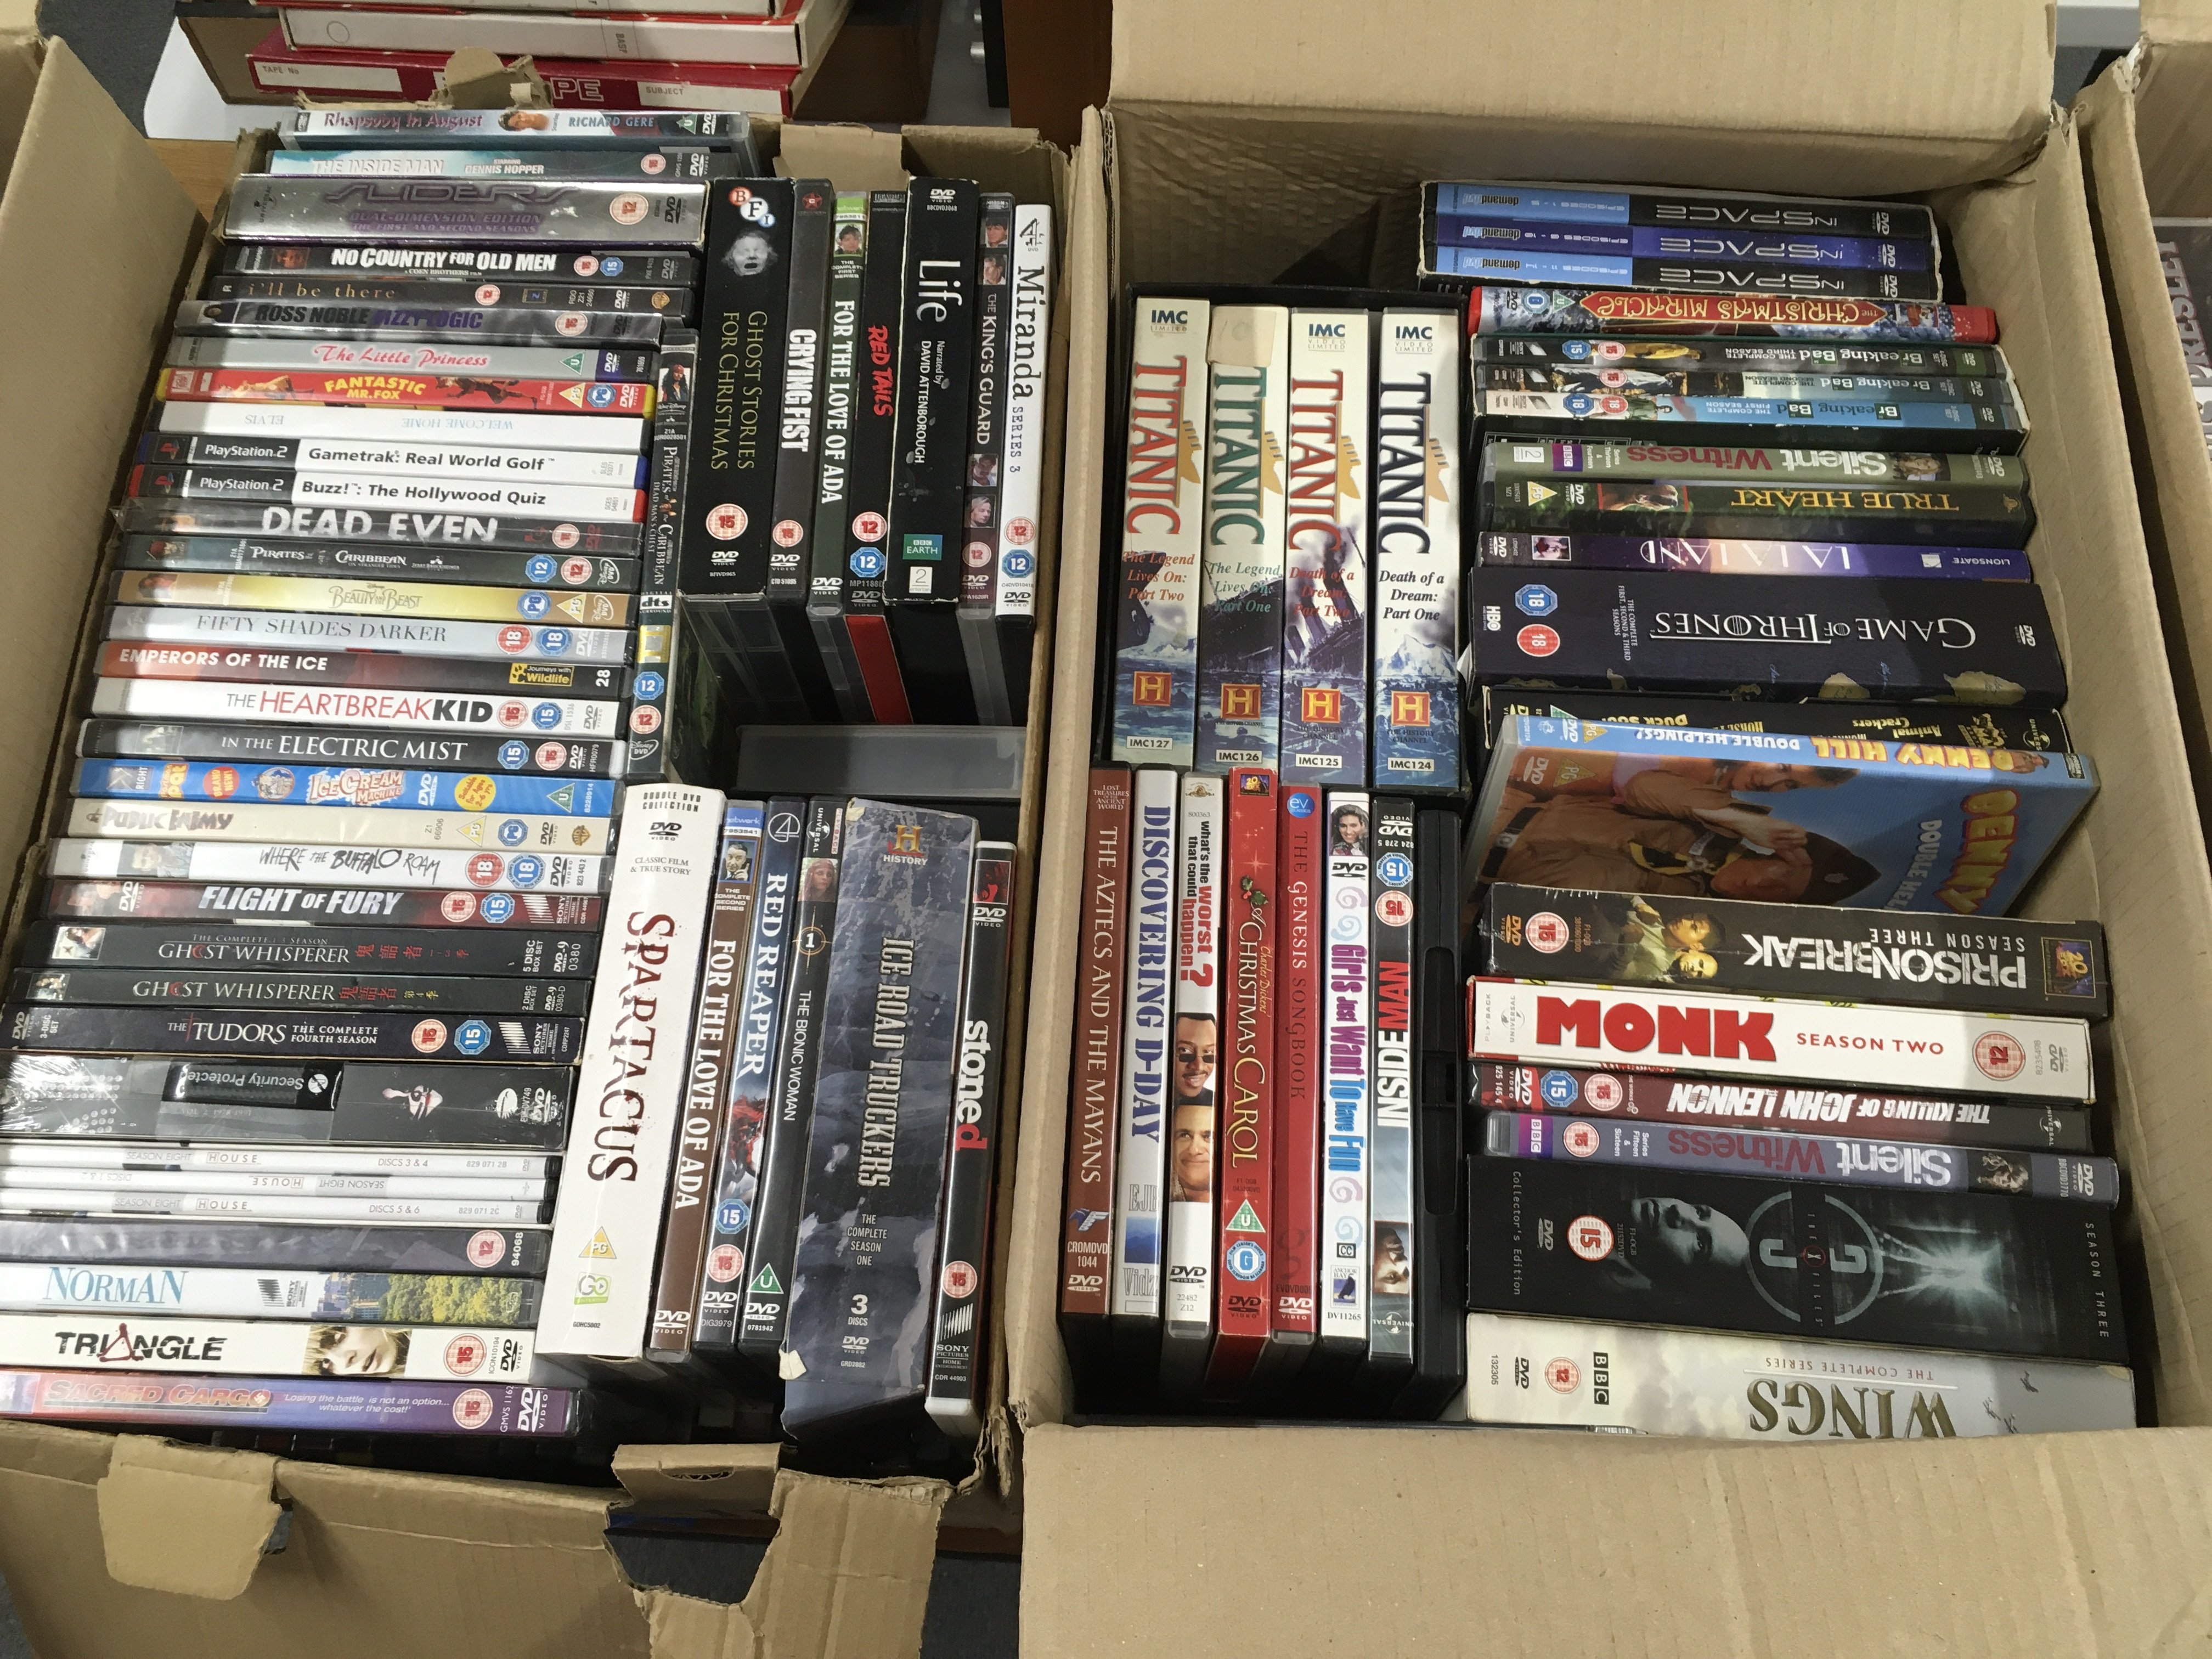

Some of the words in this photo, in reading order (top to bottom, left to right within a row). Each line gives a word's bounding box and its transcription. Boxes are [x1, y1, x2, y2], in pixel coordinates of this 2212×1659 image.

[263, 66, 284, 75] TAPE
[646, 87, 684, 96] SUBJECT
[568, 116, 620, 127] RICHARD
[626, 117, 654, 128] GERE
[465, 165, 501, 174] DENNIS
[504, 165, 544, 174] HOPPER
[331, 249, 358, 267] NO
[360, 249, 447, 268] COUNTRY
[449, 253, 474, 266] FOR
[477, 252, 512, 270] OLD
[515, 253, 557, 272] MEN
[915, 259, 962, 323] Life
[255, 306, 306, 323] ROSS
[309, 307, 368, 324] NOBLE
[1150, 309, 1188, 325] IMC
[1599, 295, 1708, 319] MIRACLE
[1717, 300, 1860, 323] CHRISTMAS
[720, 312, 741, 349] FOR
[867, 324, 889, 365] RED
[979, 314, 998, 376] KING'S
[1308, 323, 1346, 338] IMC
[744, 310, 768, 382] GHOST
[918, 340, 933, 375] DAVID
[783, 329, 818, 402] CRYING
[324, 376, 426, 396] FANTASTIC
[346, 389, 373, 399] MR.
[373, 390, 400, 400] FOX
[871, 366, 894, 418] TAILS
[711, 351, 739, 470] CHRISTMAS
[912, 377, 929, 465] ATTENBOROUGH
[977, 380, 995, 445] GUARD
[737, 385, 759, 469] STORIES
[781, 405, 814, 453] FIST
[1126, 355, 1188, 535] TITANIC
[1627, 447, 1773, 471] Witness
[405, 453, 443, 466] Real
[449, 455, 501, 468] World
[507, 456, 545, 472] Golf
[1288, 369, 1344, 551] TITANIC
[1376, 371, 1432, 555] TITANIC
[1782, 449, 1887, 476] Silent
[369, 485, 399, 498] The
[405, 486, 501, 504] Hollywood
[507, 490, 546, 506] Quiz
[1731, 488, 1855, 508] HEART
[1864, 493, 1960, 511] TRUE
[262, 506, 373, 539] DEAD
[387, 513, 498, 542] EVEN
[906, 544, 939, 556] EARTH
[1953, 557, 2011, 566] LIONSGATE
[1379, 570, 1418, 584] Death
[1419, 572, 1434, 586] of
[1435, 574, 1444, 585] a
[1390, 588, 1438, 602] Dream:
[197, 614, 261, 633] FIFTY
[265, 617, 352, 637] SHADES
[360, 622, 447, 642] DARKER
[1383, 607, 1412, 621] Part
[1414, 608, 1441, 622] One
[1486, 606, 1501, 631] HBO
[119, 648, 219, 666] EMPERORS
[225, 652, 252, 668] OF
[257, 654, 290, 669] THE
[295, 656, 328, 671] ICE
[527, 673, 570, 684] Wildlife
[596, 669, 611, 687] 28
[222, 737, 239, 748] IN
[244, 738, 274, 750] THE
[278, 735, 401, 759] ELECTRIC
[404, 741, 468, 760] MIST
[1129, 738, 1170, 749] IMC127
[1218, 752, 1260, 761] IMC126
[1390, 760, 1431, 771] IMC124
[1098, 826, 1118, 868] THE
[1188, 836, 1198, 861] that
[1200, 821, 1211, 861] what's
[634, 856, 666, 865] CLASSIC
[668, 858, 690, 866] FILM
[883, 854, 929, 866] HISTORY
[1199, 861, 1209, 884] the
[1187, 862, 1197, 897] could
[199, 885, 302, 912] FLIGHT
[301, 893, 325, 909] OF
[325, 891, 404, 916] FURY
[763, 872, 788, 938] RED
[1093, 873, 1116, 958] AZTECS
[1136, 805, 1171, 1028] DISCOVERING
[1197, 885, 1214, 954] worst
[1869, 927, 1934, 946] THREE
[1946, 933, 2026, 952] SEASON
[708, 939, 737, 988] FOR
[880, 936, 916, 977] ICE
[797, 990, 812, 1016] THE
[1091, 965, 1111, 1018] AND
[1378, 961, 1409, 1030] MAN
[697, 993, 730, 1042] THE
[735, 943, 781, 1079] REAPER
[872, 983, 912, 1051] ROAD
[167, 1022, 187, 1032] THE
[193, 1023, 287, 1044] TUDORS
[292, 1025, 315, 1033] THE
[319, 1025, 379, 1035] COMPLETE
[790, 1019, 809, 1064] BIONIC
[1536, 994, 1778, 1063] MONK
[1087, 1025, 1109, 1071] THE
[1796, 1032, 1884, 1051] SEASON
[1891, 1039, 1944, 1056] TWO
[689, 1046, 720, 1108] LOVE
[954, 1020, 991, 1152] stoned
[1131, 1038, 1164, 1143] D-DAY
[1377, 1030, 1409, 1128] INSIDE
[783, 1066, 803, 1122] WOMAN
[685, 1112, 712, 1153] OF
[857, 1059, 903, 1187] TRUCKERS
[1080, 1079, 1106, 1184] MAYANS
[1531, 1118, 1542, 1153] BBC
[378, 1158, 403, 1167] DISCS
[1667, 1129, 1826, 1175] Witness
[1836, 1142, 1951, 1187] Silent
[674, 1155, 706, 1210] ADA
[861, 1214, 877, 1225] THE
[1513, 1171, 1522, 1242] Collector's
[847, 1227, 888, 1239] COMPLETE
[850, 1240, 882, 1253] SEASON
[1067, 1241, 1108, 1254] CROMDVD
[511, 1232, 524, 1266] 94068
[856, 1255, 872, 1267] ONE
[1077, 1256, 1098, 1268] 1044
[42, 1266, 189, 1305] NORMAN
[1513, 1248, 1522, 1296] Edition
[2084, 1222, 2102, 1279] SEASON
[2095, 1290, 2109, 1339] THREE
[850, 1294, 868, 1315] 3
[848, 1316, 868, 1327] DISCS
[54, 1322, 228, 1362] TRIANGLE
[1491, 1355, 1499, 1385] 132305
[1765, 1356, 1813, 1372] SERIES
[1820, 1362, 1899, 1378] COMPLETE
[1907, 1368, 1934, 1381] THE
[319, 1403, 364, 1413] whatever
[365, 1404, 381, 1413] the
[1747, 1377, 1957, 1440] WINGS
